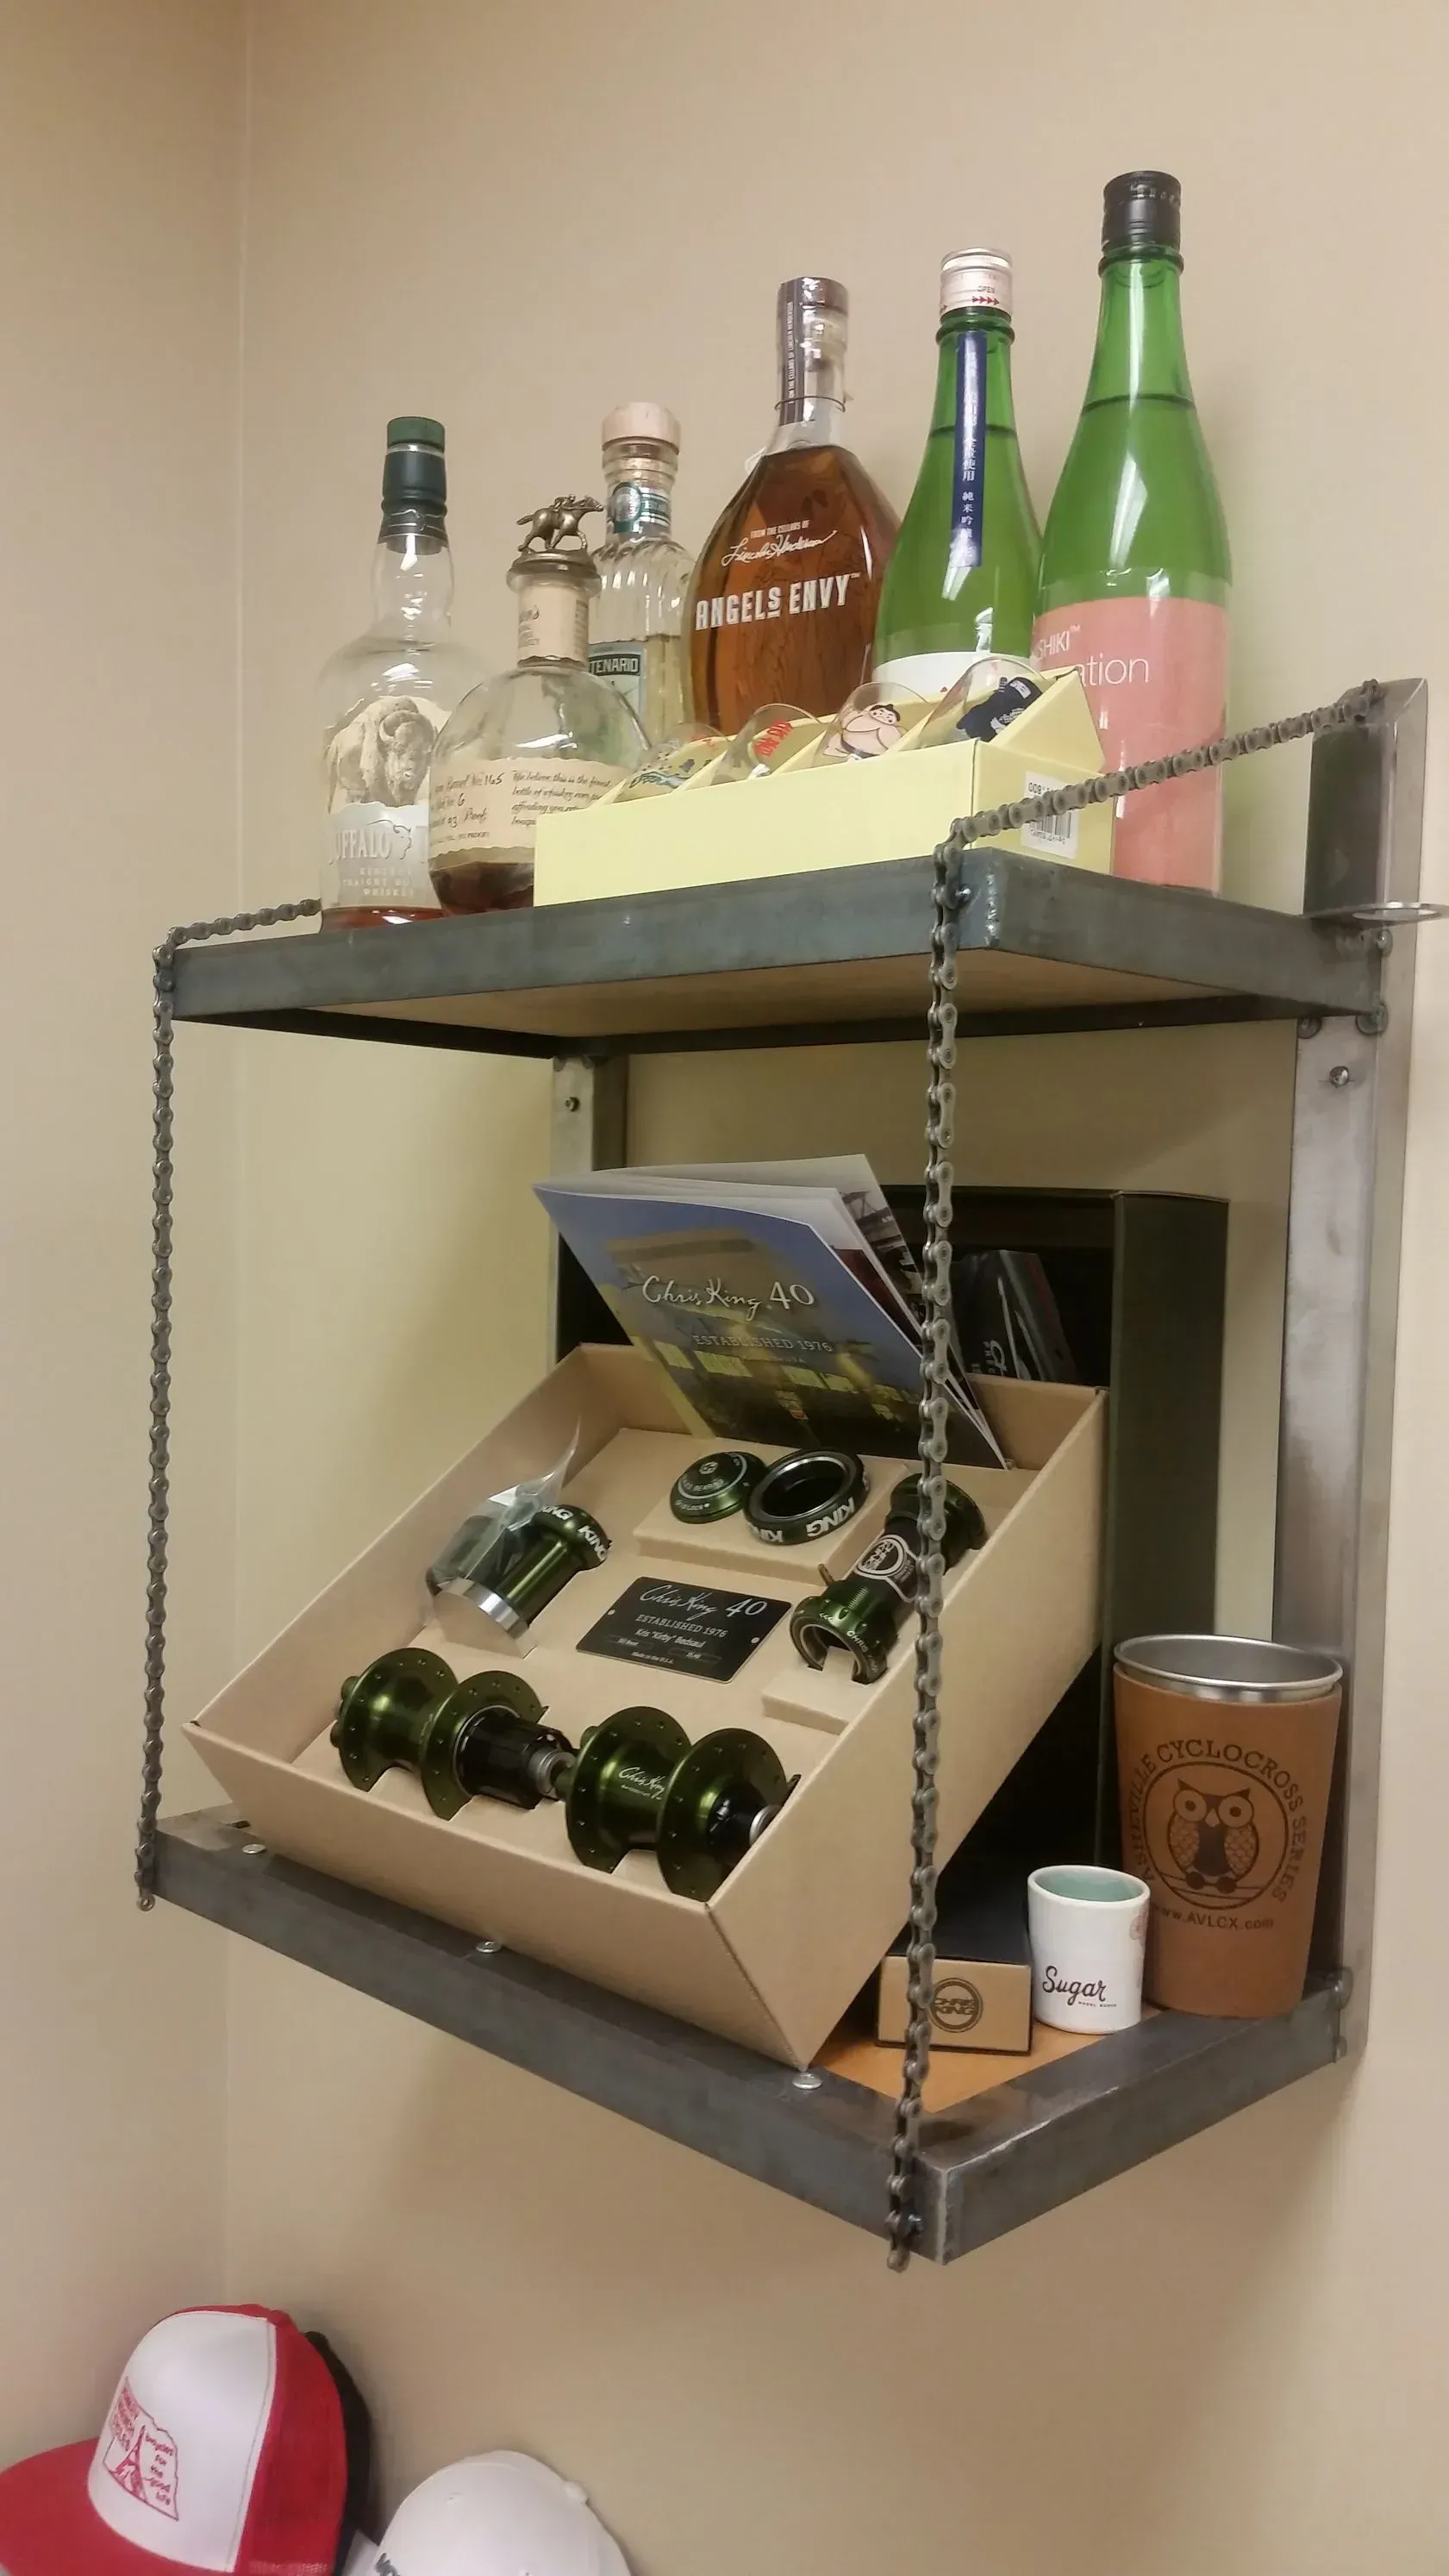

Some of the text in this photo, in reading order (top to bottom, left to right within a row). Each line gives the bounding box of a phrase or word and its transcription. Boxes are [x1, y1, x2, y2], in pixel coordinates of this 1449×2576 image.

[695, 586, 783, 631] ANGELS
[590, 657, 639, 673] TENARIO
[641, 1275, 815, 1322] Chris King 40
[692, 1335, 834, 1353] ESTABLISHED 1976
[806, 1496, 855, 1538] KING
[577, 1524, 609, 1562] KING
[639, 1584, 768, 1621] Chris King 40
[634, 1613, 729, 1639] ESTABLISHED 1976
[1128, 1739, 1307, 1903] ASHEVILLE CYCLOCROSS SERIES
[1042, 1965, 1107, 2006] Sugar
